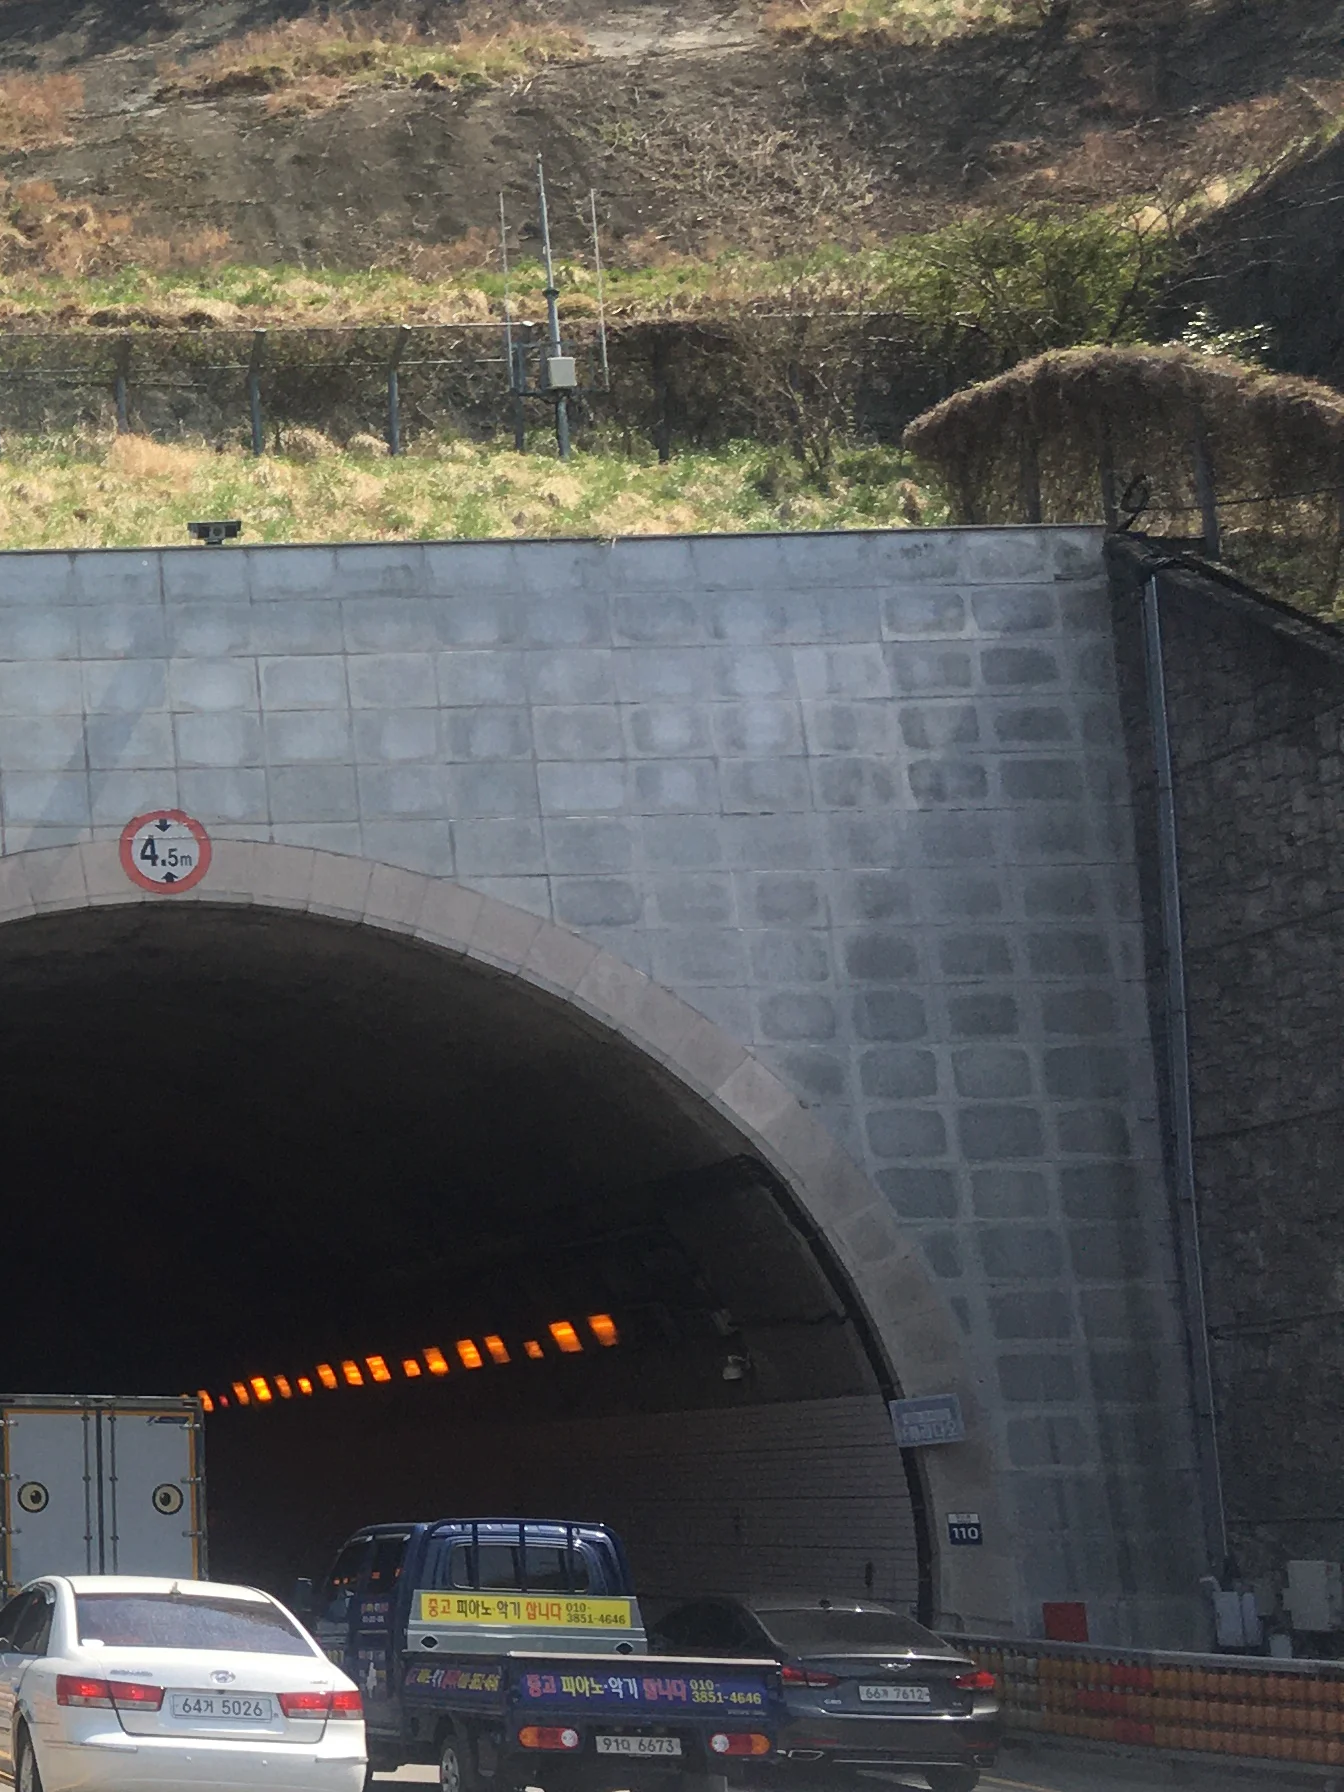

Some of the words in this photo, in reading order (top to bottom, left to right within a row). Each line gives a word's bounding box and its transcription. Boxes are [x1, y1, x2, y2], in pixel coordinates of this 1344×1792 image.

[140, 834, 193, 867] 4.5m
[952, 1526, 979, 1540] 110
[427, 1598, 451, 1618] 중고
[525, 1601, 562, 1621] 삽니다
[566, 1613, 626, 1625] 3851-4646
[691, 1690, 762, 1705] 3851-4646
[893, 1687, 924, 1700] 7612
[182, 1697, 214, 1714] 64거
[221, 1699, 263, 1717] 5026
[637, 1738, 675, 1753] 6673
